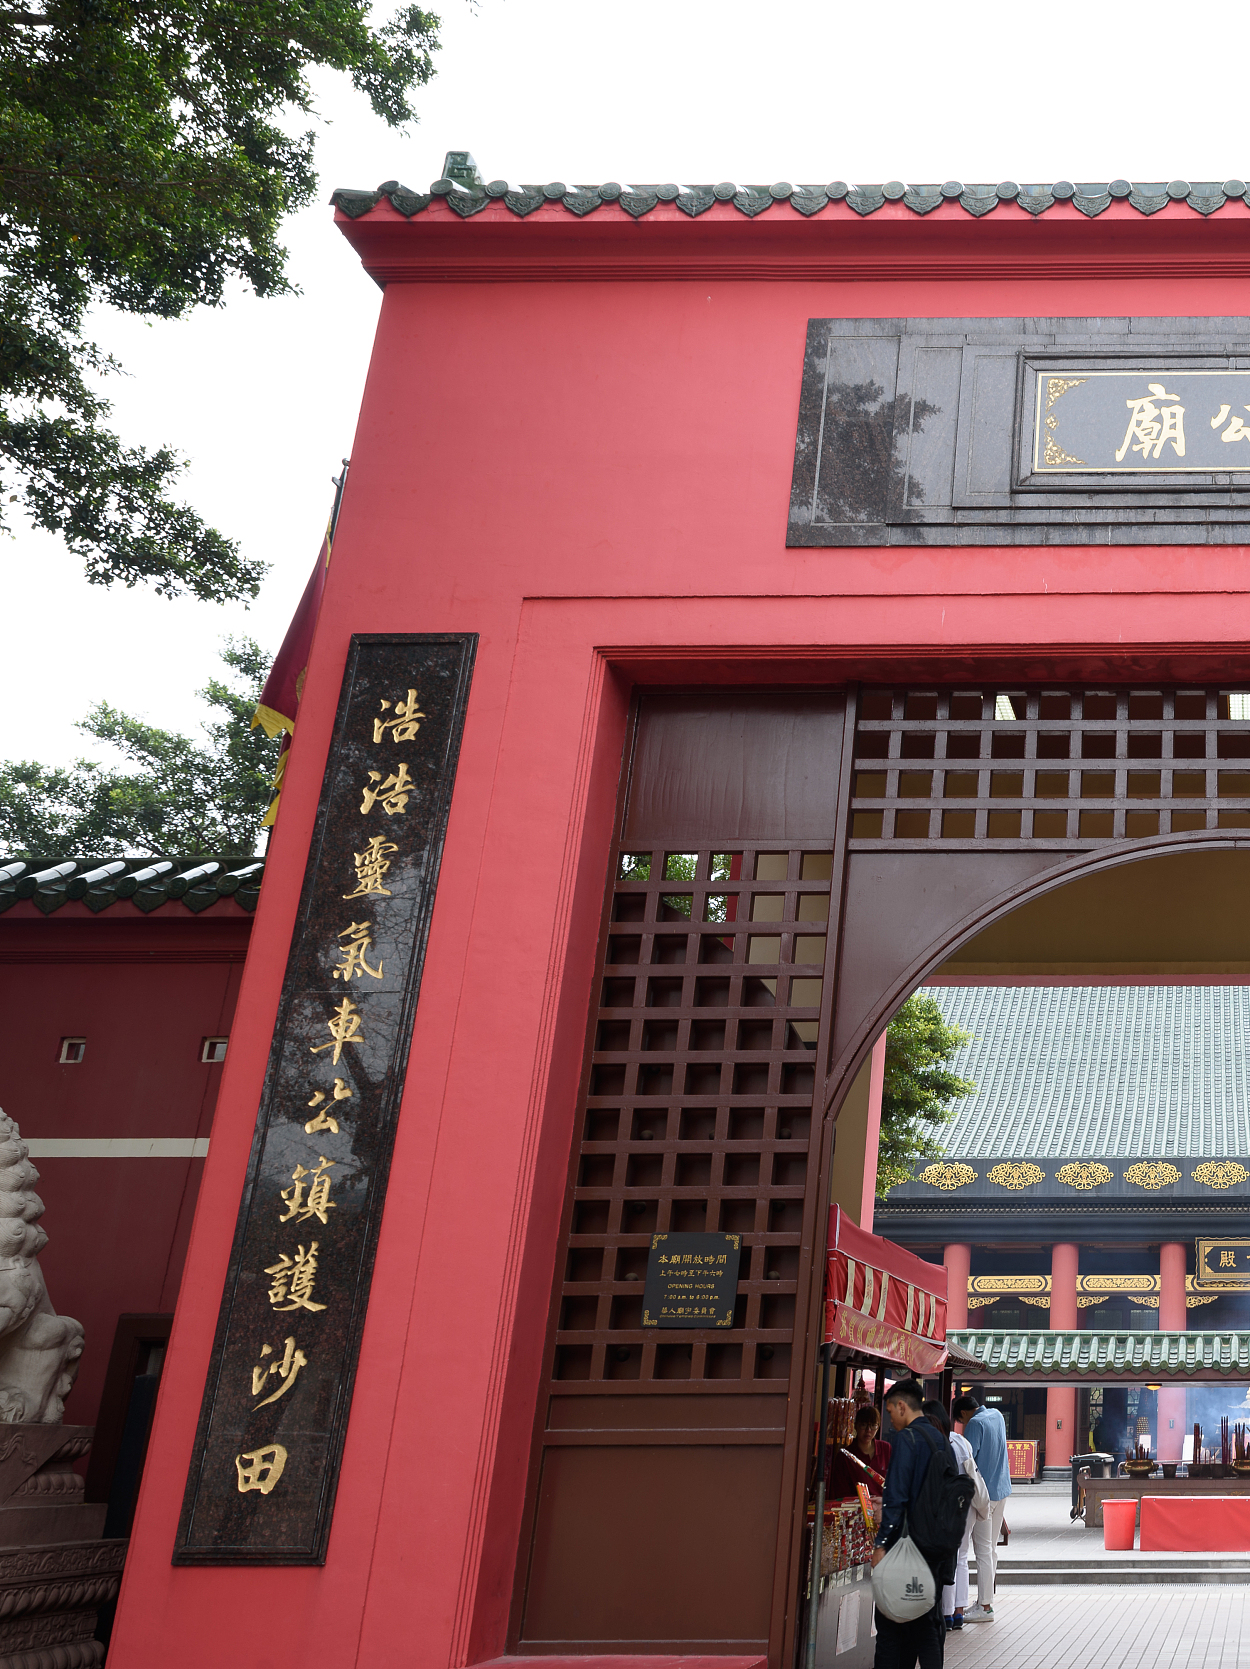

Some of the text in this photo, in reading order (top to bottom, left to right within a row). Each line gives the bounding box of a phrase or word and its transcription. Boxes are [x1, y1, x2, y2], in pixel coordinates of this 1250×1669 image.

[235, 689, 426, 1495] 浩浩靈氣車公鎮護沙田
[658, 1254, 728, 1265] 本廟開放時間
